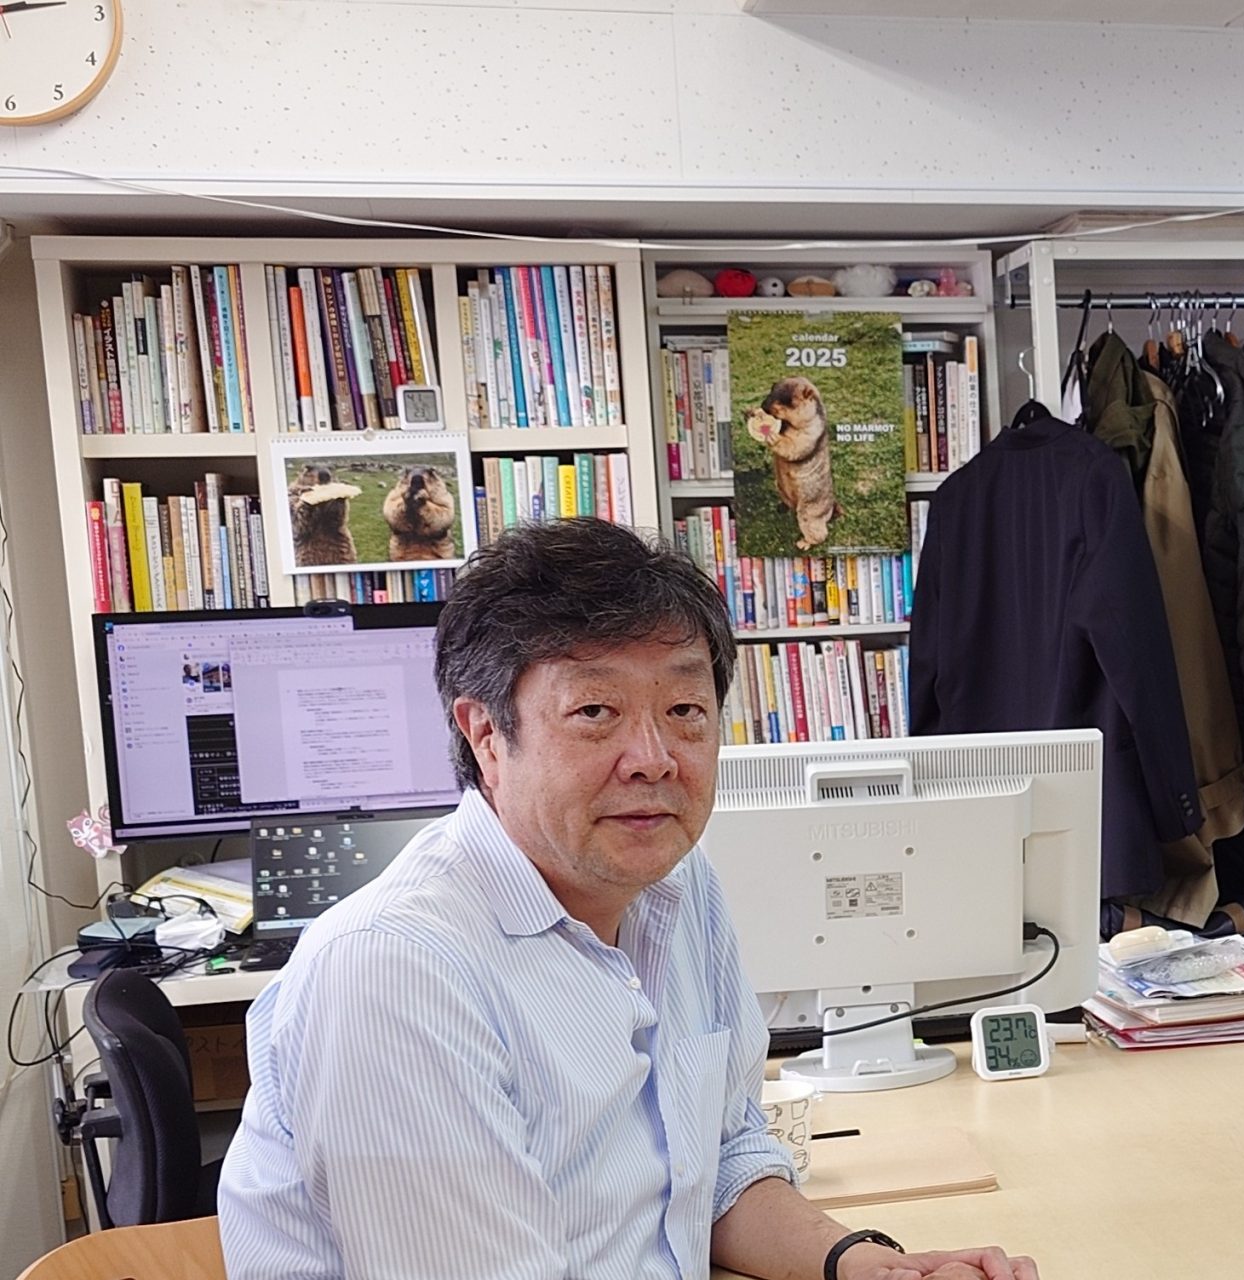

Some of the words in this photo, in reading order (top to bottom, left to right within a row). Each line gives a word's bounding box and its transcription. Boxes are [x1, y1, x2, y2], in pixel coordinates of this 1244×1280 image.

[94, 5, 105, 21] 3
[85, 51, 97, 66] 4
[53, 84, 64, 100] 5
[5, 94, 16, 111] 6
[792, 333, 840, 342] calendar
[785, 347, 847, 367] 2025
[836, 424, 852, 432] NO
[853, 424, 895, 432] MARMOT
[836, 433, 852, 442] NO
[853, 433, 875, 442] LIFE
[808, 819, 918, 840] MITSUBISHI
